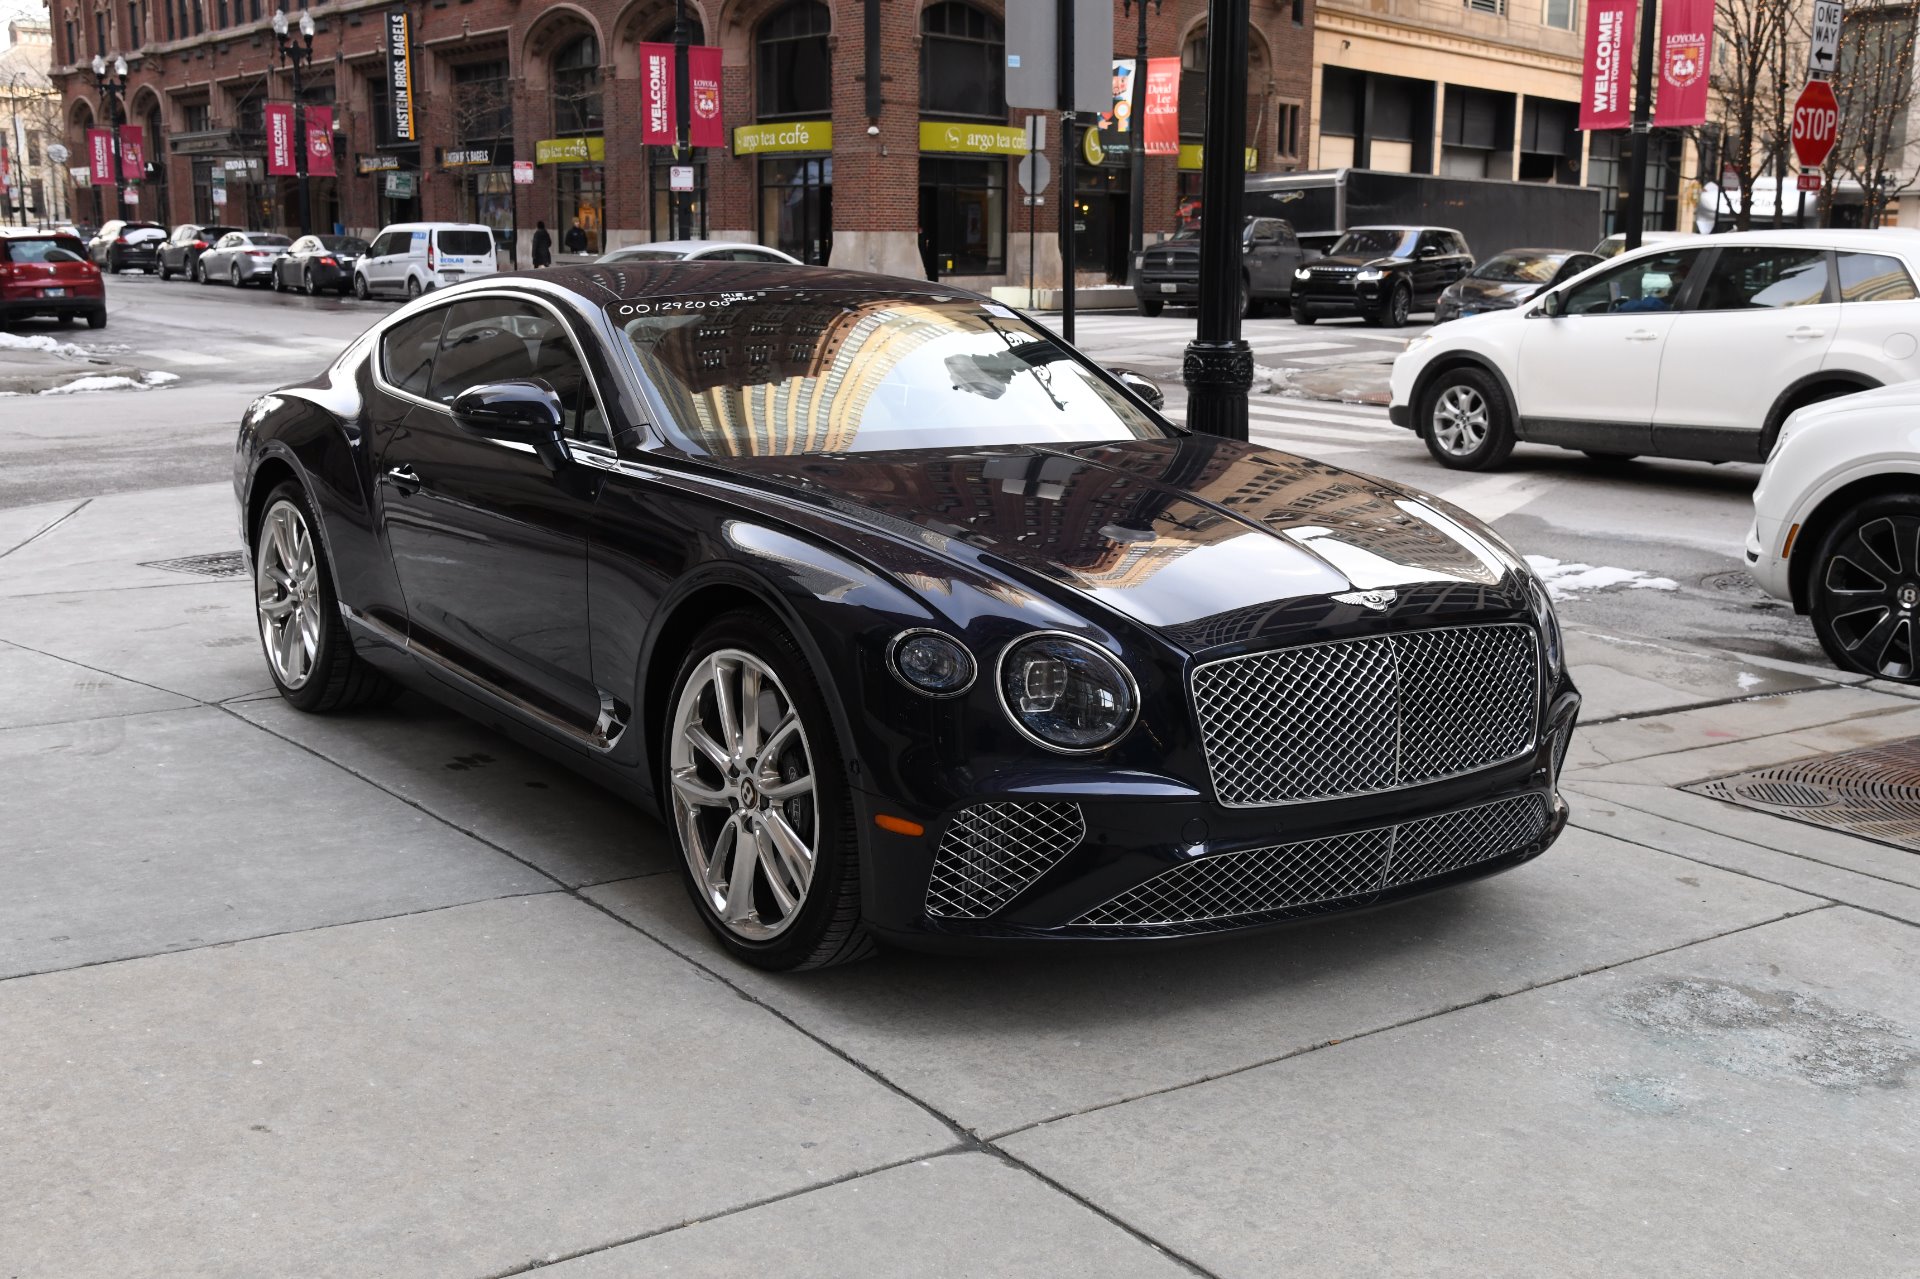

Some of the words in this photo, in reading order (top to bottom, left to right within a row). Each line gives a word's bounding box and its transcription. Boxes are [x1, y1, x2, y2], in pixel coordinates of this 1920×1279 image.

[1613, 10, 1623, 49] CAMPUS
[1817, 6, 1839, 25] ONE
[392, 15, 405, 56] BAGELS
[1666, 33, 1705, 44] LOYOLA
[1815, 25, 1837, 44] WAY
[1593, 10, 1614, 113] WELCOME
[1611, 50, 1620, 81] TOWER
[649, 55, 662, 132] WELCOME
[693, 79, 718, 88] LOYOLA
[1147, 83, 1172, 94] David
[1609, 82, 1618, 112] WATER
[396, 90, 409, 138] EINSTEIN
[1156, 95, 1171, 104] Lee
[761, 131, 776, 146] tea
[778, 123, 809, 145] café
[1794, 107, 1836, 141] STOP
[272, 113, 284, 166] WELCOME
[564, 139, 588, 157] café
[966, 133, 995, 151] argo
[996, 133, 1010, 148] tea
[94, 136, 104, 178] WELCOME
